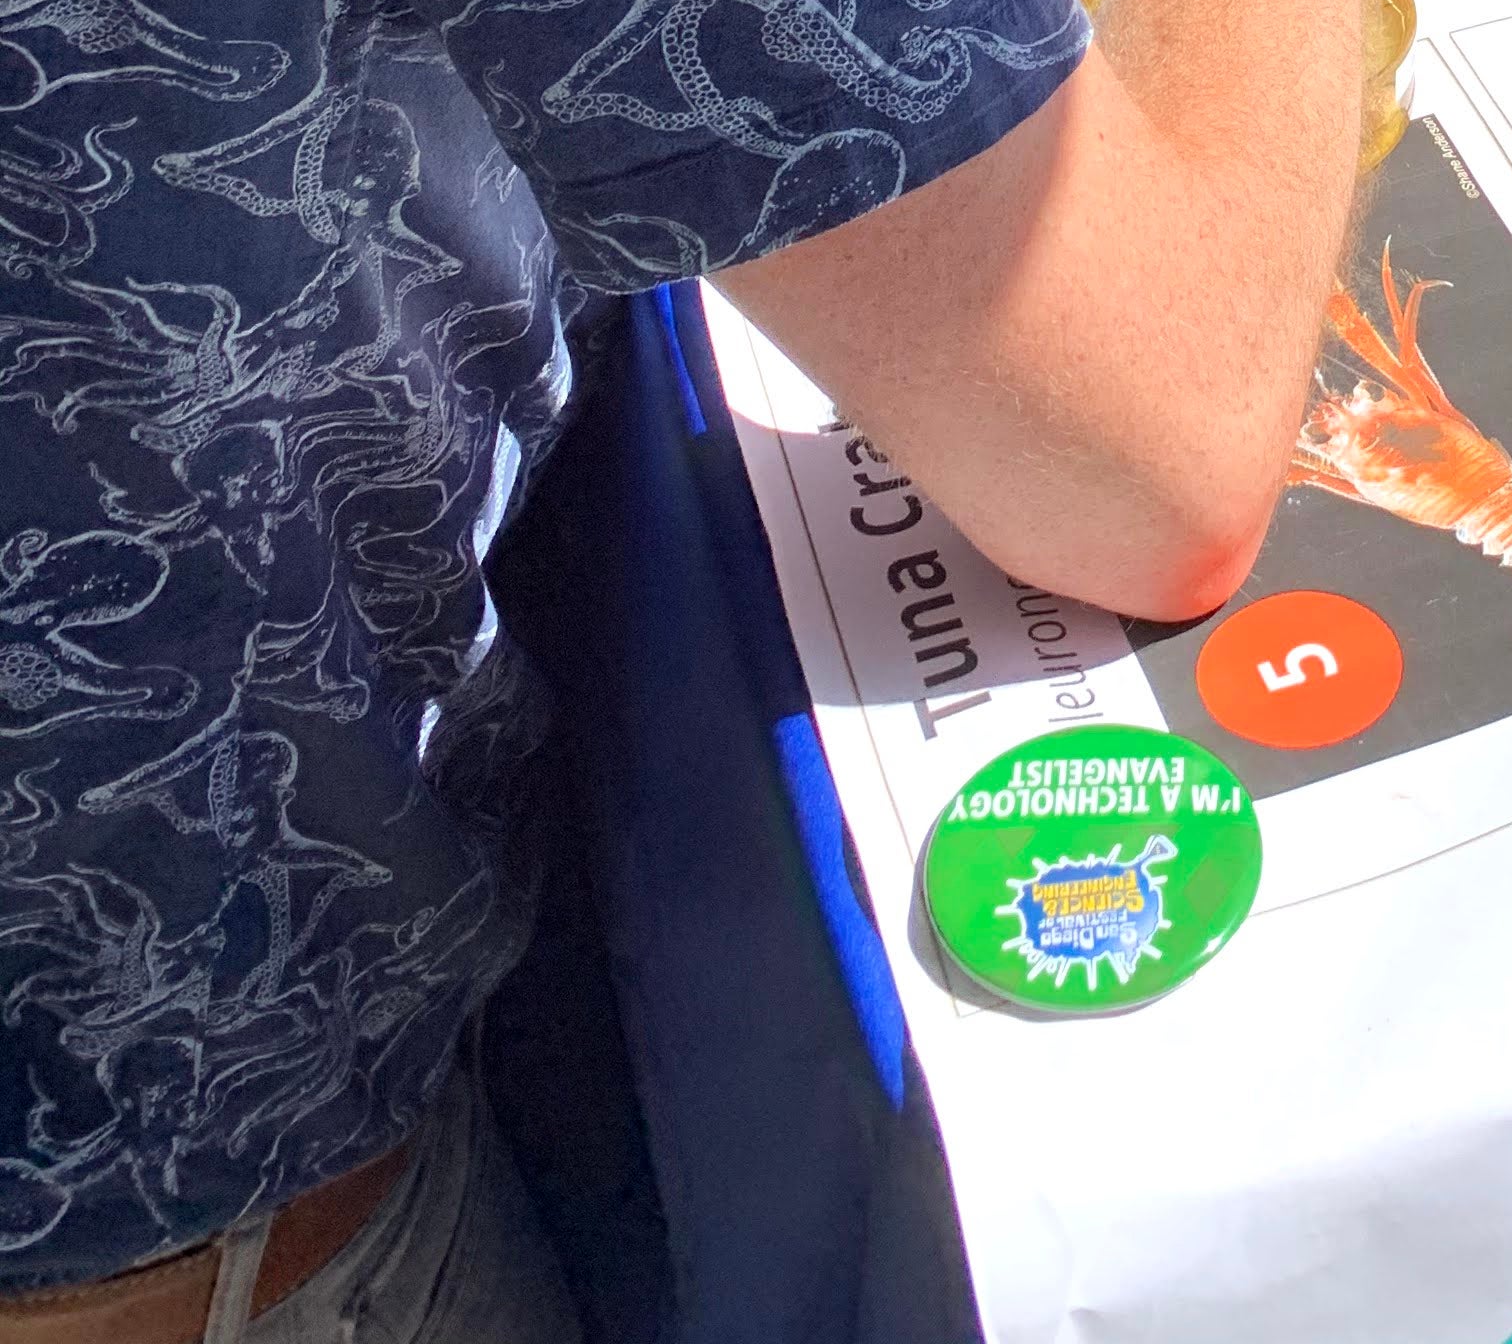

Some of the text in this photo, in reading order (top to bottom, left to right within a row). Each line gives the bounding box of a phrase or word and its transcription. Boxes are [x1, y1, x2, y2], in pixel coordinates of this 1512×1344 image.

[817, 422, 992, 742] Tuna Cra
[1007, 574, 1104, 724] leuron
[1257, 642, 1339, 694] 5
[1007, 756, 1186, 789] EVANGELIST
[947, 784, 1241, 823] I'M A TECHNOLOGY
[1031, 867, 1139, 903] ENGINEERING
[1040, 920, 1139, 951] San Diego
